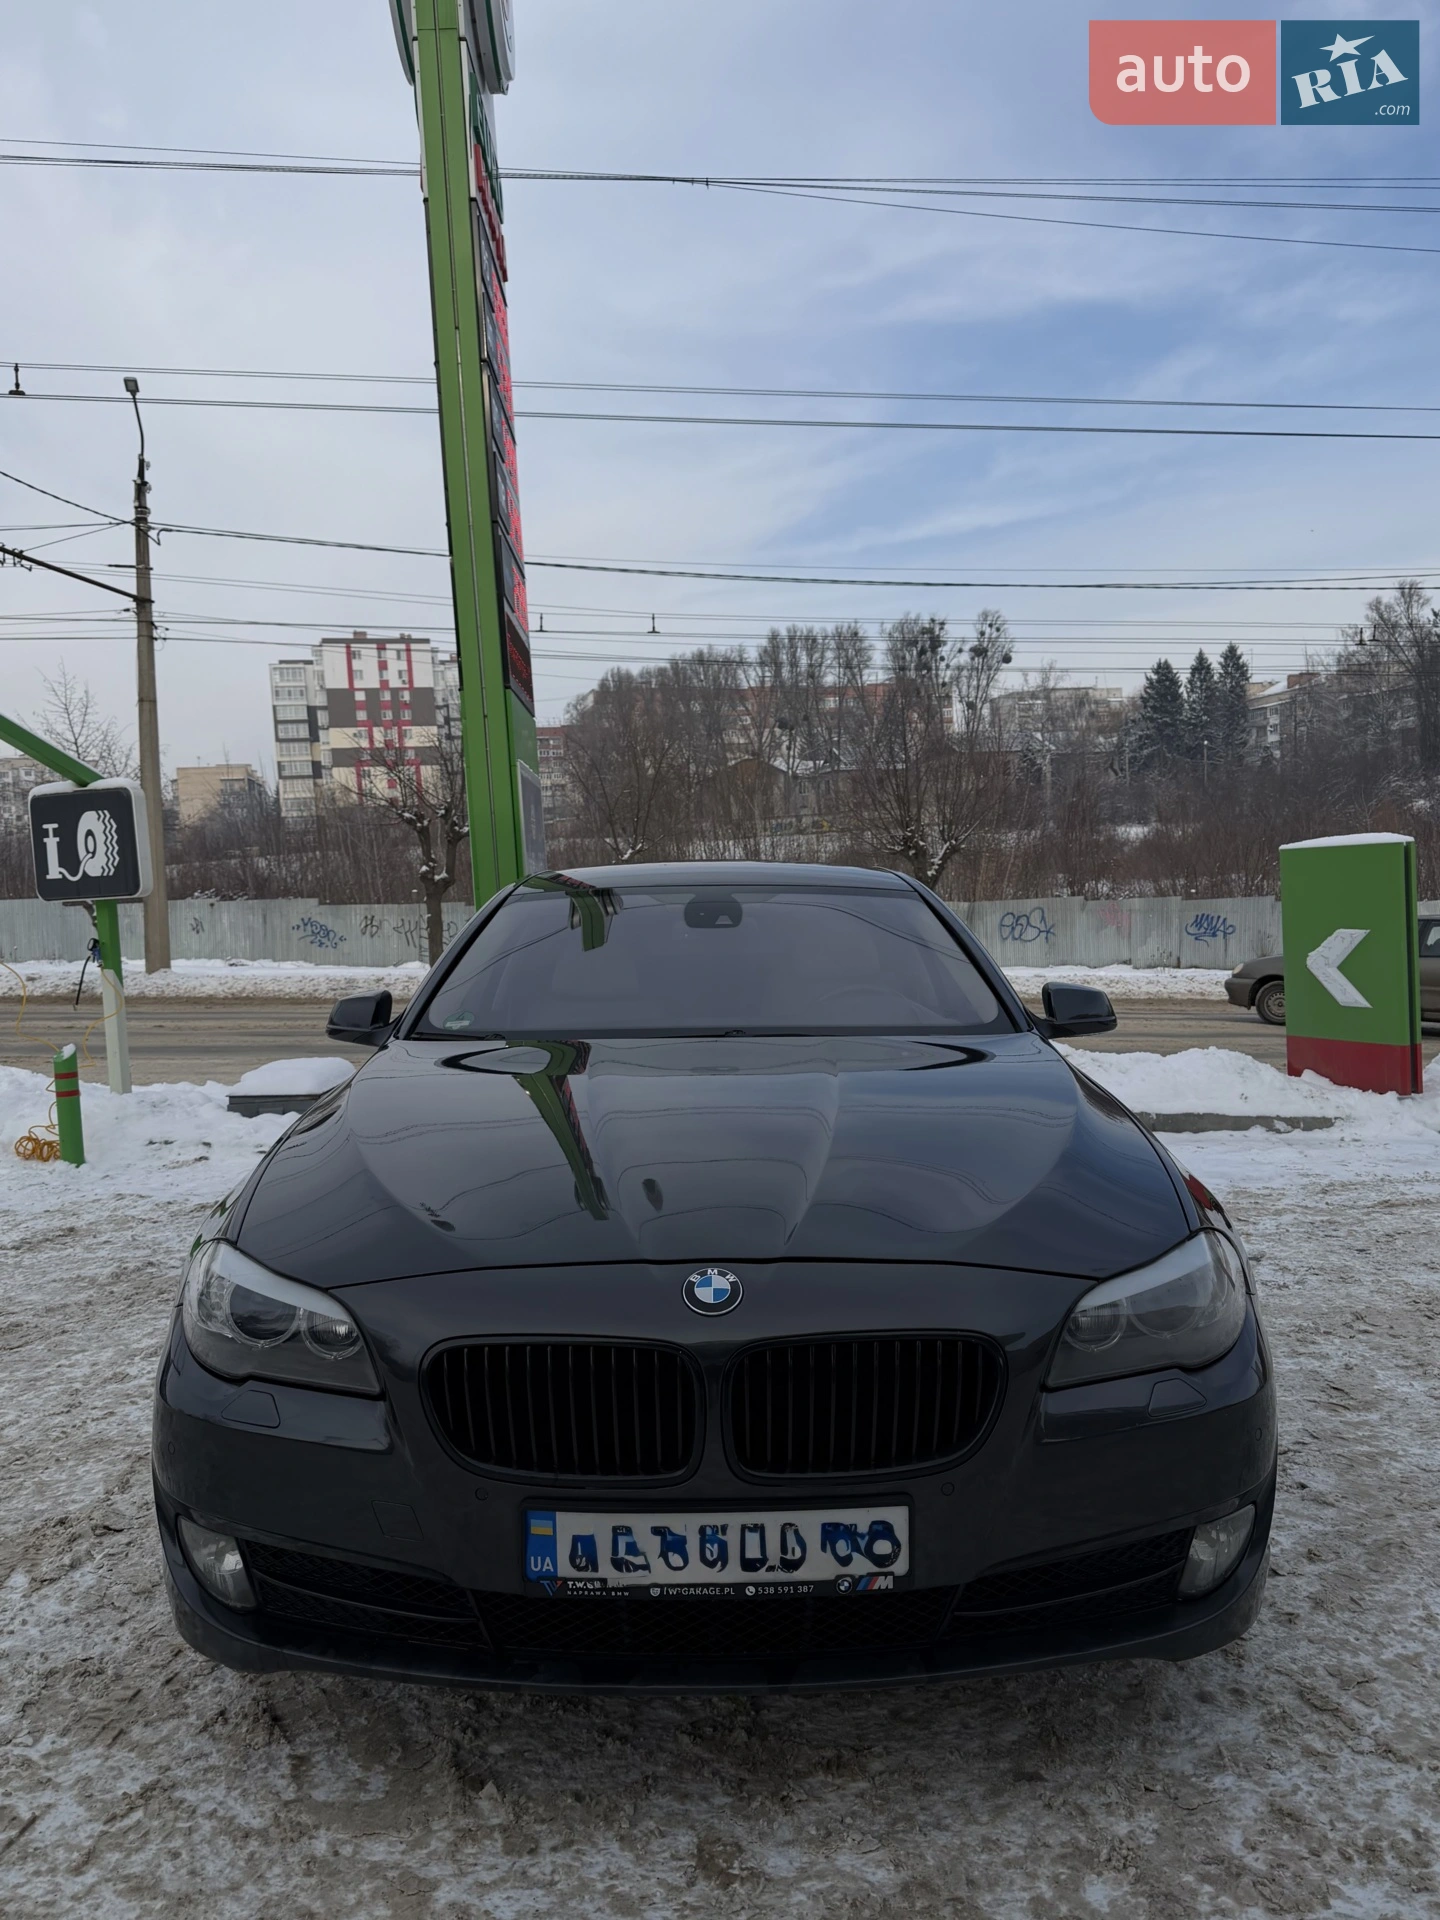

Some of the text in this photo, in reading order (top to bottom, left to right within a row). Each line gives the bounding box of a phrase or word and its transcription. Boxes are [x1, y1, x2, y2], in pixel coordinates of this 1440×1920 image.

[689, 1268, 737, 1283] BMW
[530, 1556, 554, 1572] UA
[757, 1584, 815, 1595] 538 591 387
